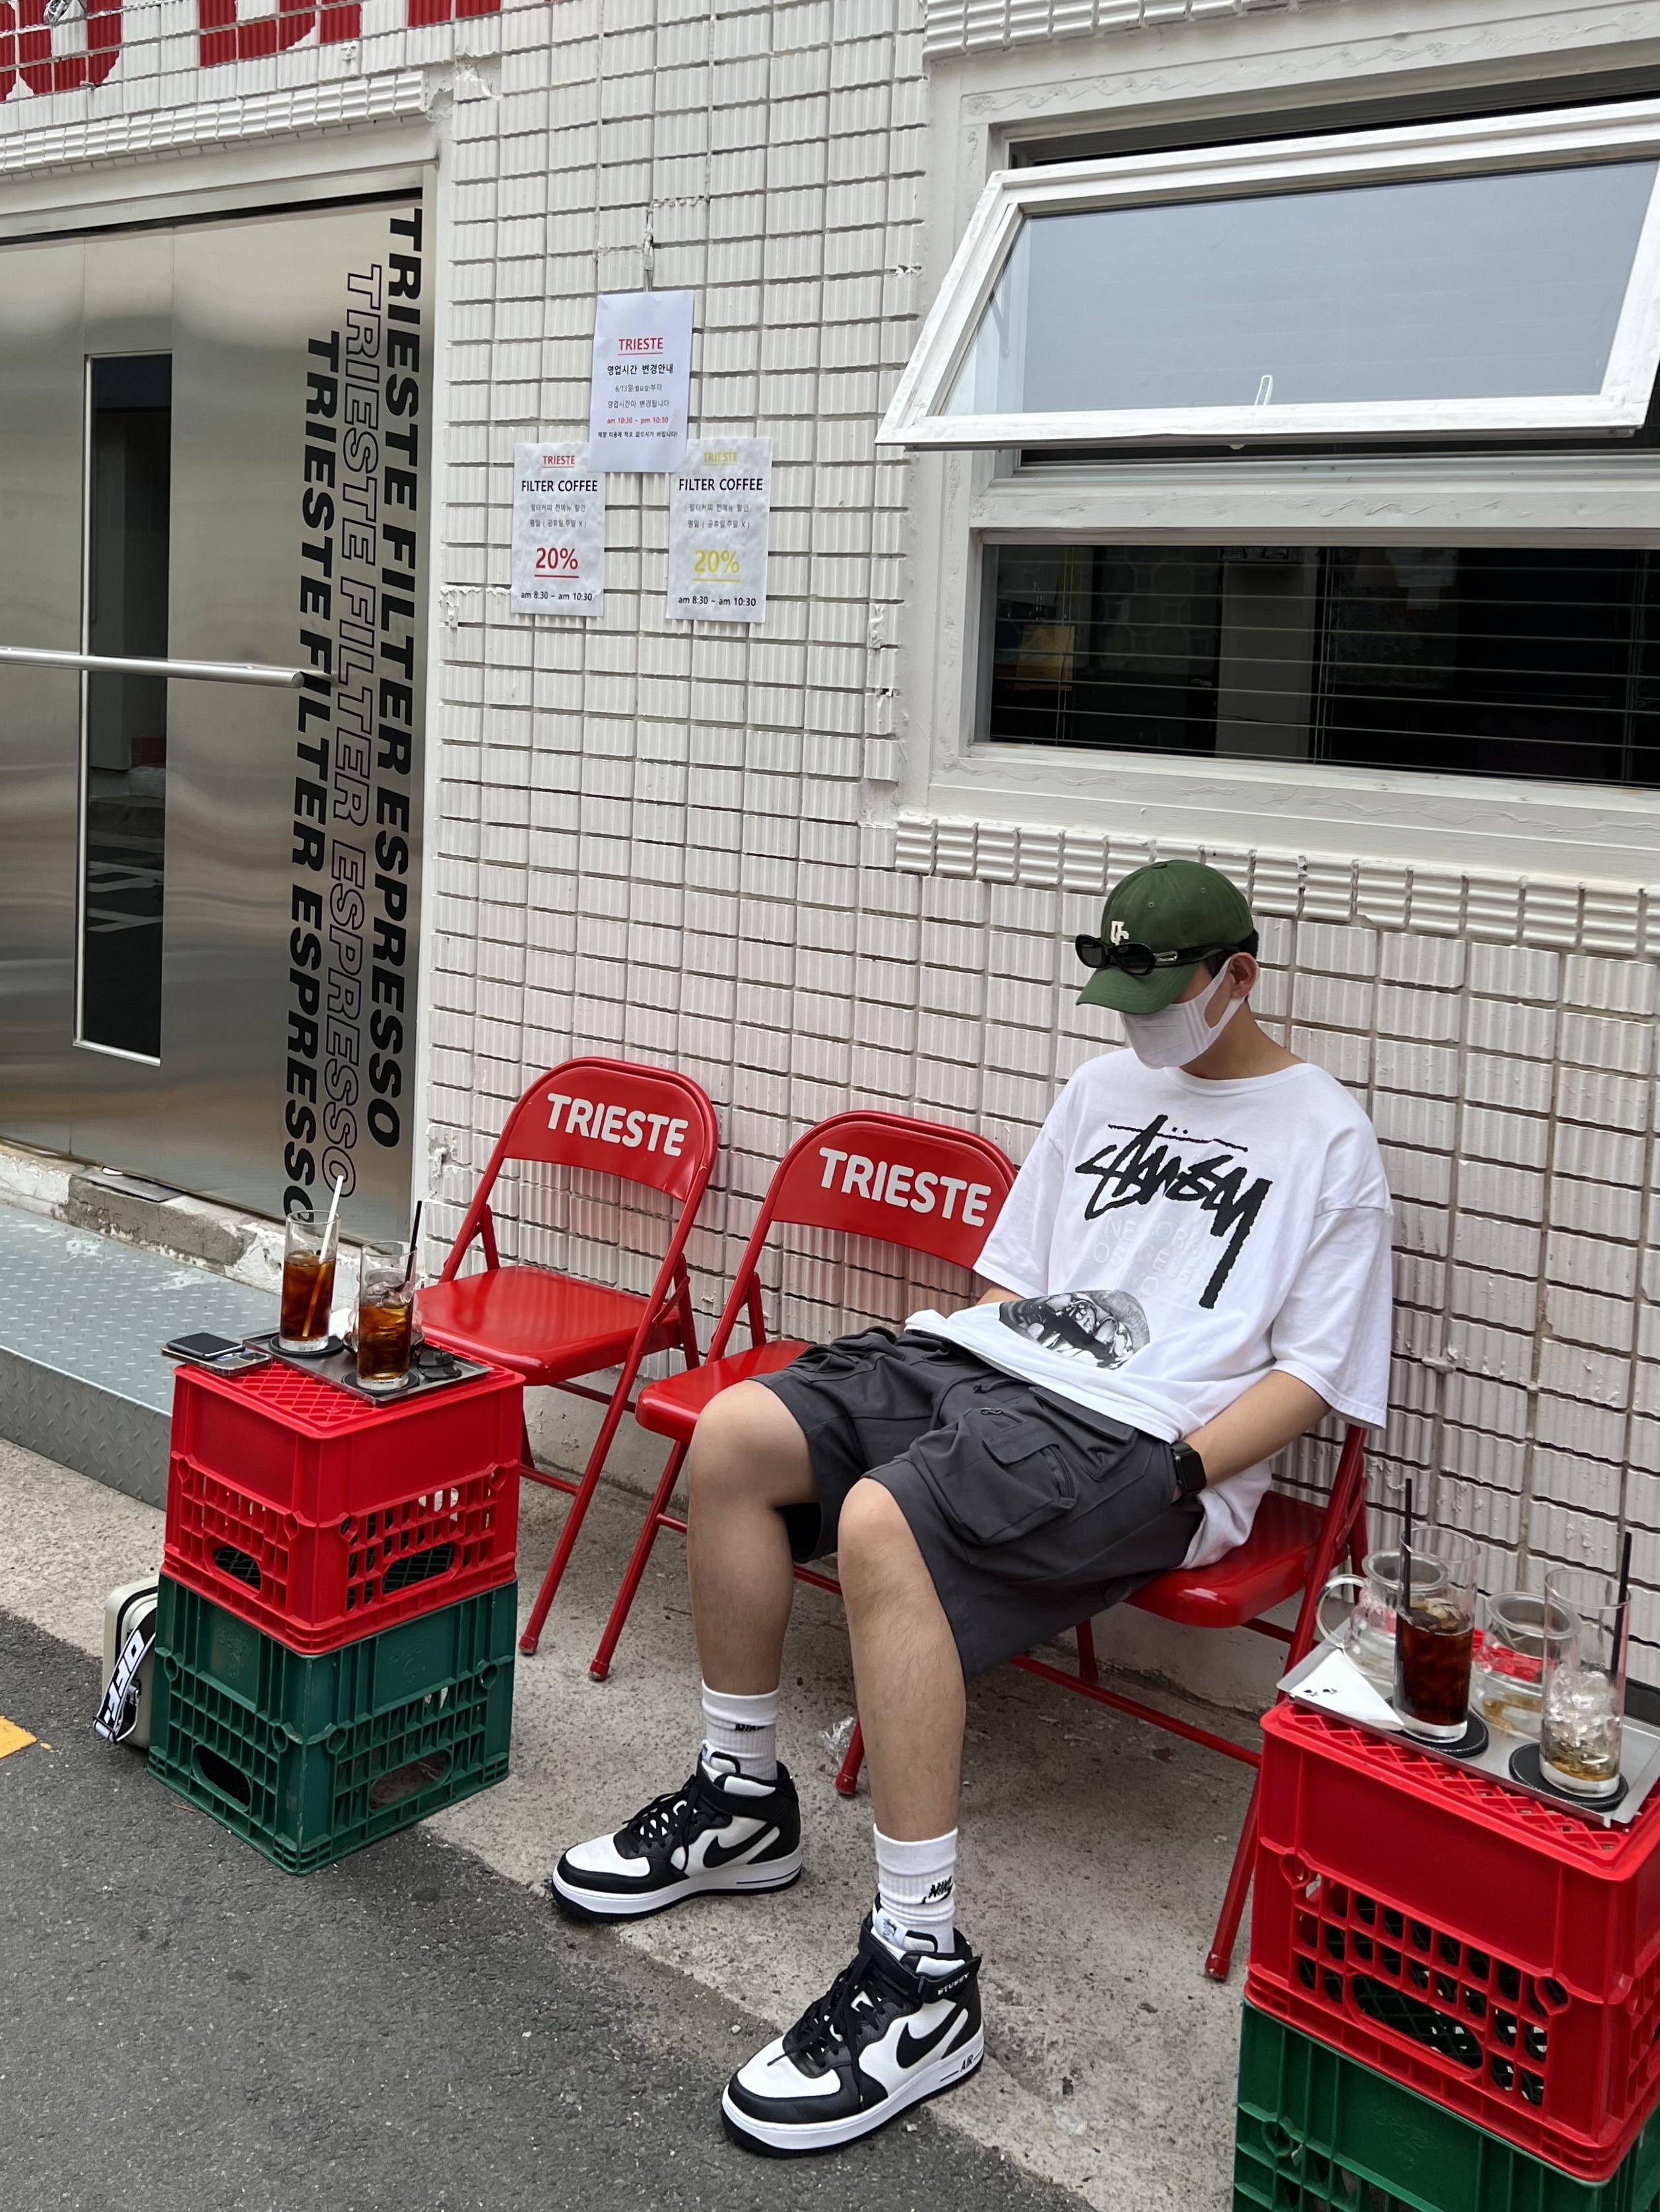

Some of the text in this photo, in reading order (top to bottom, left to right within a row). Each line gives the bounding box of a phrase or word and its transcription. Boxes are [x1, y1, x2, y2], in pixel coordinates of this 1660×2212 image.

[618, 337, 663, 351] TRIESTE
[607, 363, 674, 376] 영업시간 변경안내
[607, 399, 669, 409] 영업시간이 변경됩니다
[543, 455, 575, 465] TRIESTE
[704, 452, 738, 463] TRIESTE
[521, 480, 598, 492] FILTER COFFEE
[679, 478, 763, 491] FILTER COFFEE
[689, 504, 714, 512] 필터커피
[535, 547, 578, 570] 20%
[694, 549, 741, 573] 20%
[573, 592, 593, 601] 10:30
[692, 595, 708, 605] 8:30
[734, 597, 756, 606] 10:30
[367, 207, 422, 1148] TRIESTE FILTER ESPRESSO
[322, 263, 382, 1197] TRIESTE FILTER ESPRESSO
[283, 330, 339, 1223] TRIESTE FILTER ESPRESSO
[547, 1092, 689, 1157] TRIESTE
[819, 1147, 992, 1227] TRIESTE
